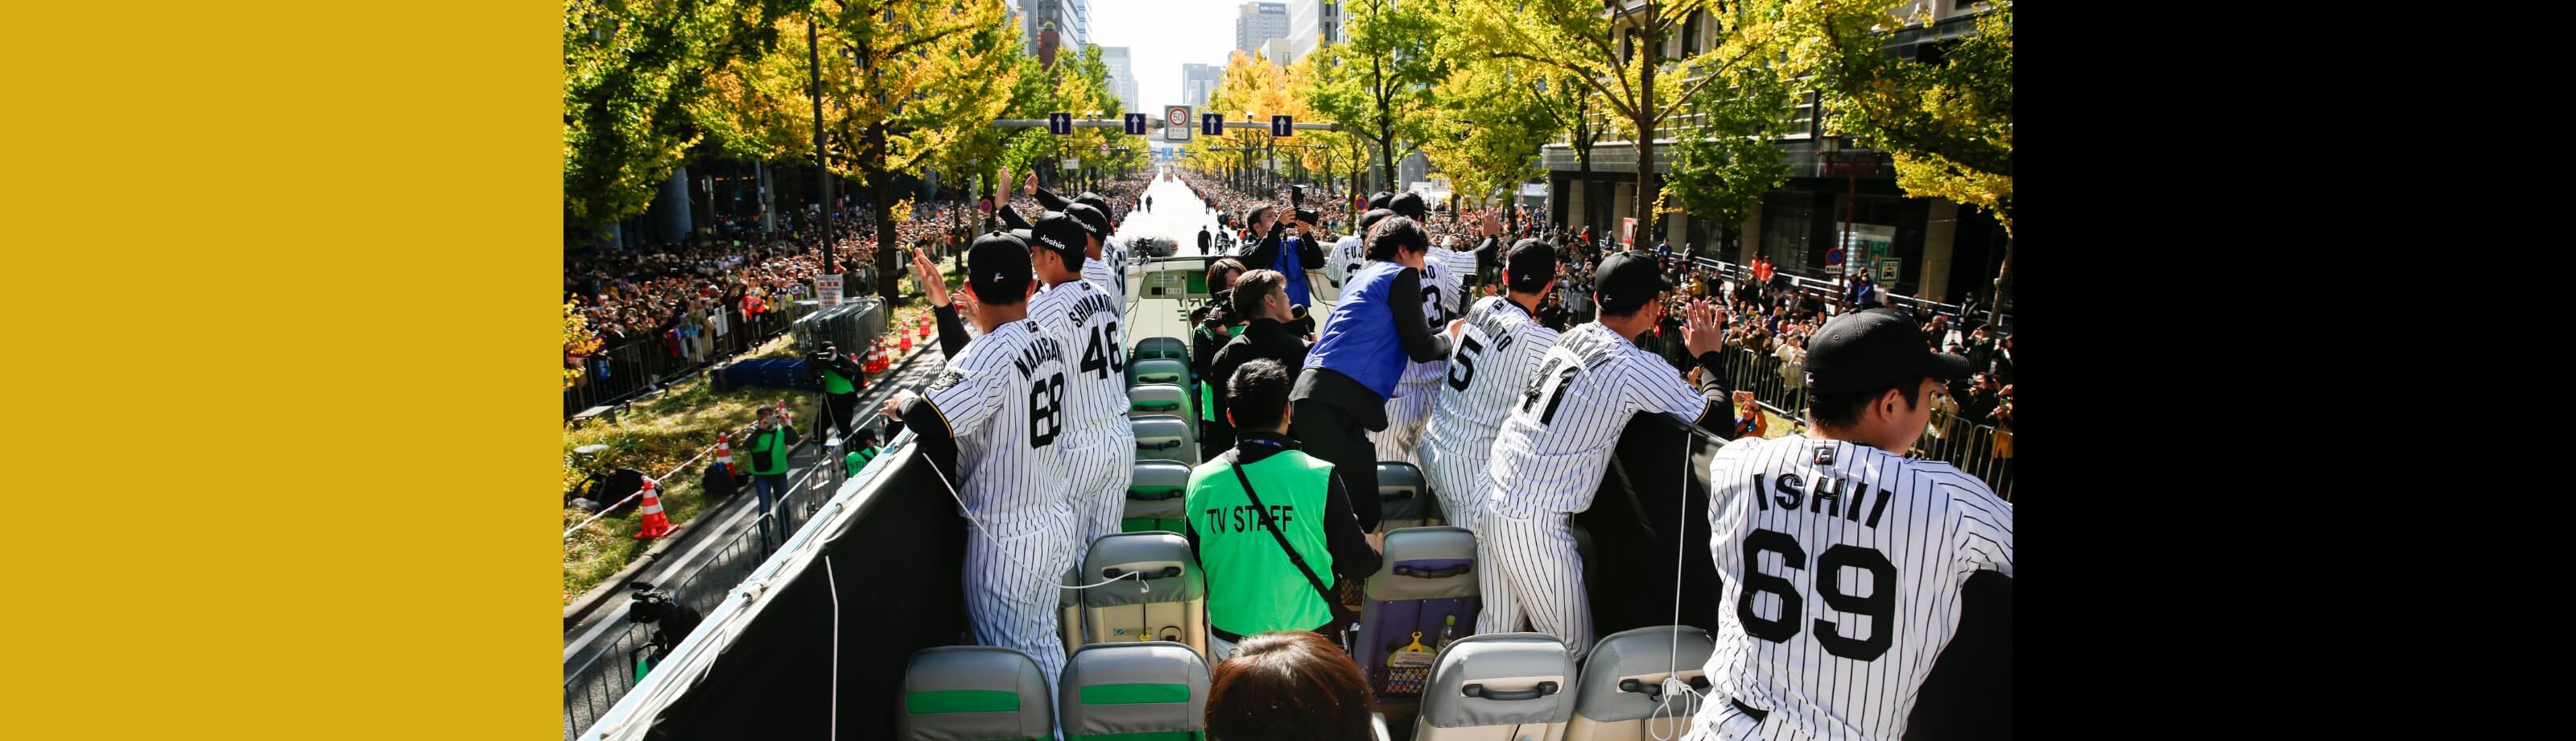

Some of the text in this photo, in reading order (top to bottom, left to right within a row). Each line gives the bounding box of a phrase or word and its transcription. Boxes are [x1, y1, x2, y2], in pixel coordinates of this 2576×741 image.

[1173, 113, 1183, 122] 50
[1040, 234, 1065, 250] Joshin
[1080, 321, 1124, 381] 46
[1448, 333, 1484, 392] 5
[1030, 371, 1065, 449] 68
[1522, 357, 1580, 426] 41
[1206, 505, 1293, 535] TV STAFF
[1753, 473, 1892, 529] ISHII
[1737, 528, 1897, 662] 69
